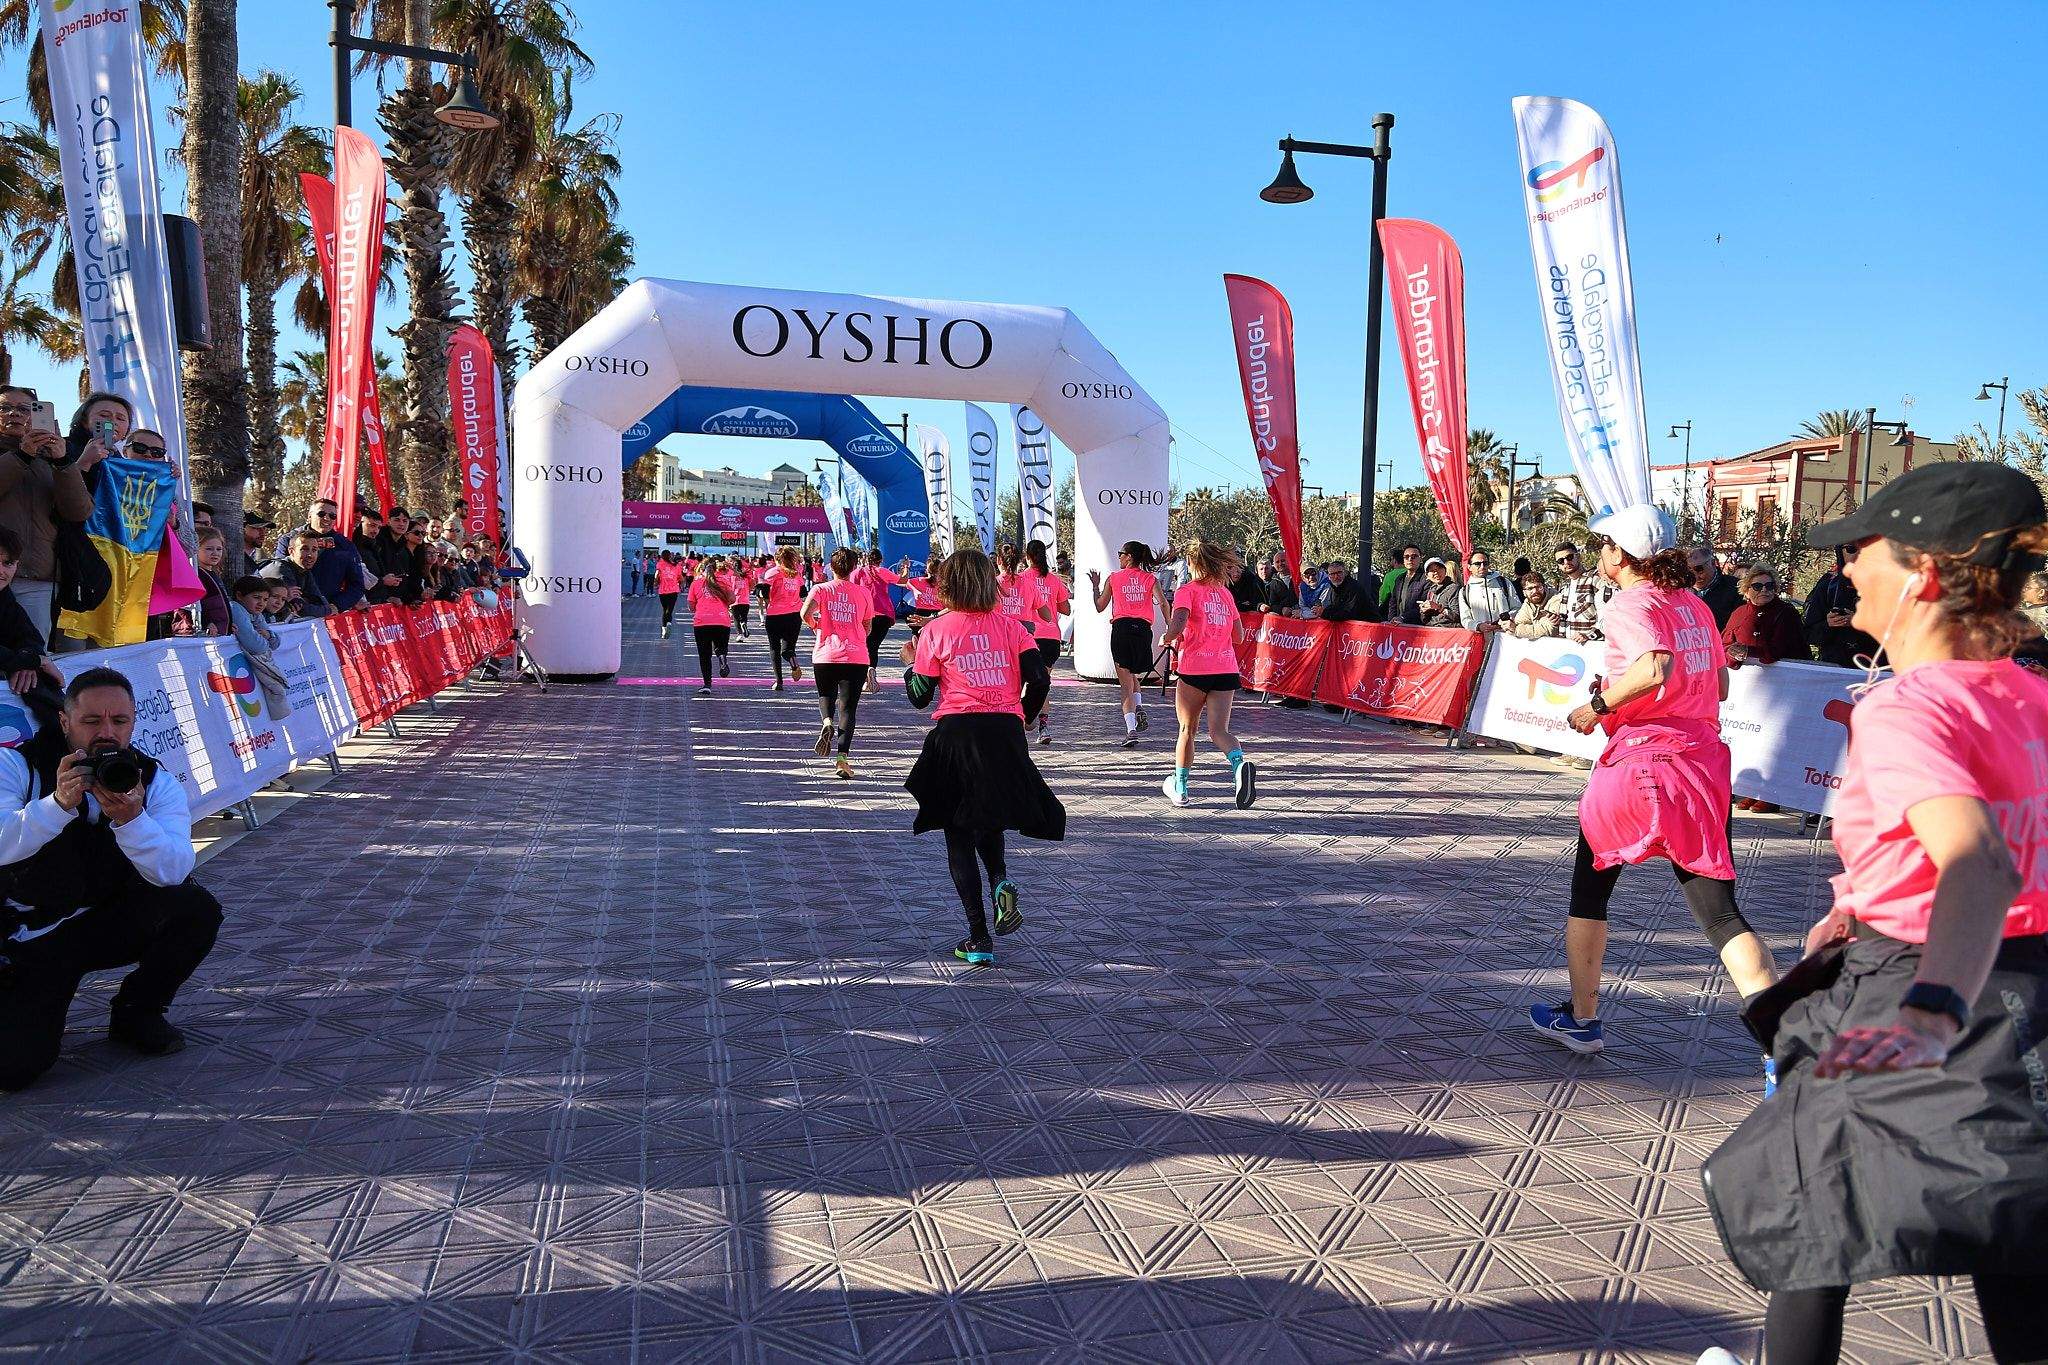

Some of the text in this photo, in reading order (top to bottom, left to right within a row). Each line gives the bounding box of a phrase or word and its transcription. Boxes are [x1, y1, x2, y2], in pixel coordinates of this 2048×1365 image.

[732, 304, 993, 369] OYSHO
[565, 355, 649, 377] OYSHO
[1062, 382, 1133, 400] OYSHO
[709, 420, 791, 436] ASTURIANA
[850, 443, 895, 453] ASTURIANA
[525, 465, 603, 484] OYSHO
[1098, 489, 1164, 506] OYSHO
[525, 576, 602, 594] OYSHO
[1122, 585, 1147, 594] DORSAL
[1129, 578, 1139, 586] TU
[837, 592, 849, 602] TU
[1126, 593, 1145, 602] SUMA
[827, 602, 856, 614] DORSAL
[831, 611, 853, 623] SUMA
[969, 633, 990, 652] TU
[1266, 626, 1316, 650] Santander
[1673, 625, 1712, 652] DORSA
[1338, 633, 1471, 664] Sports Santander
[955, 650, 1010, 672] DORSAL
[965, 669, 1007, 688] SUMA
[1504, 707, 1568, 732] TotalEnergies
